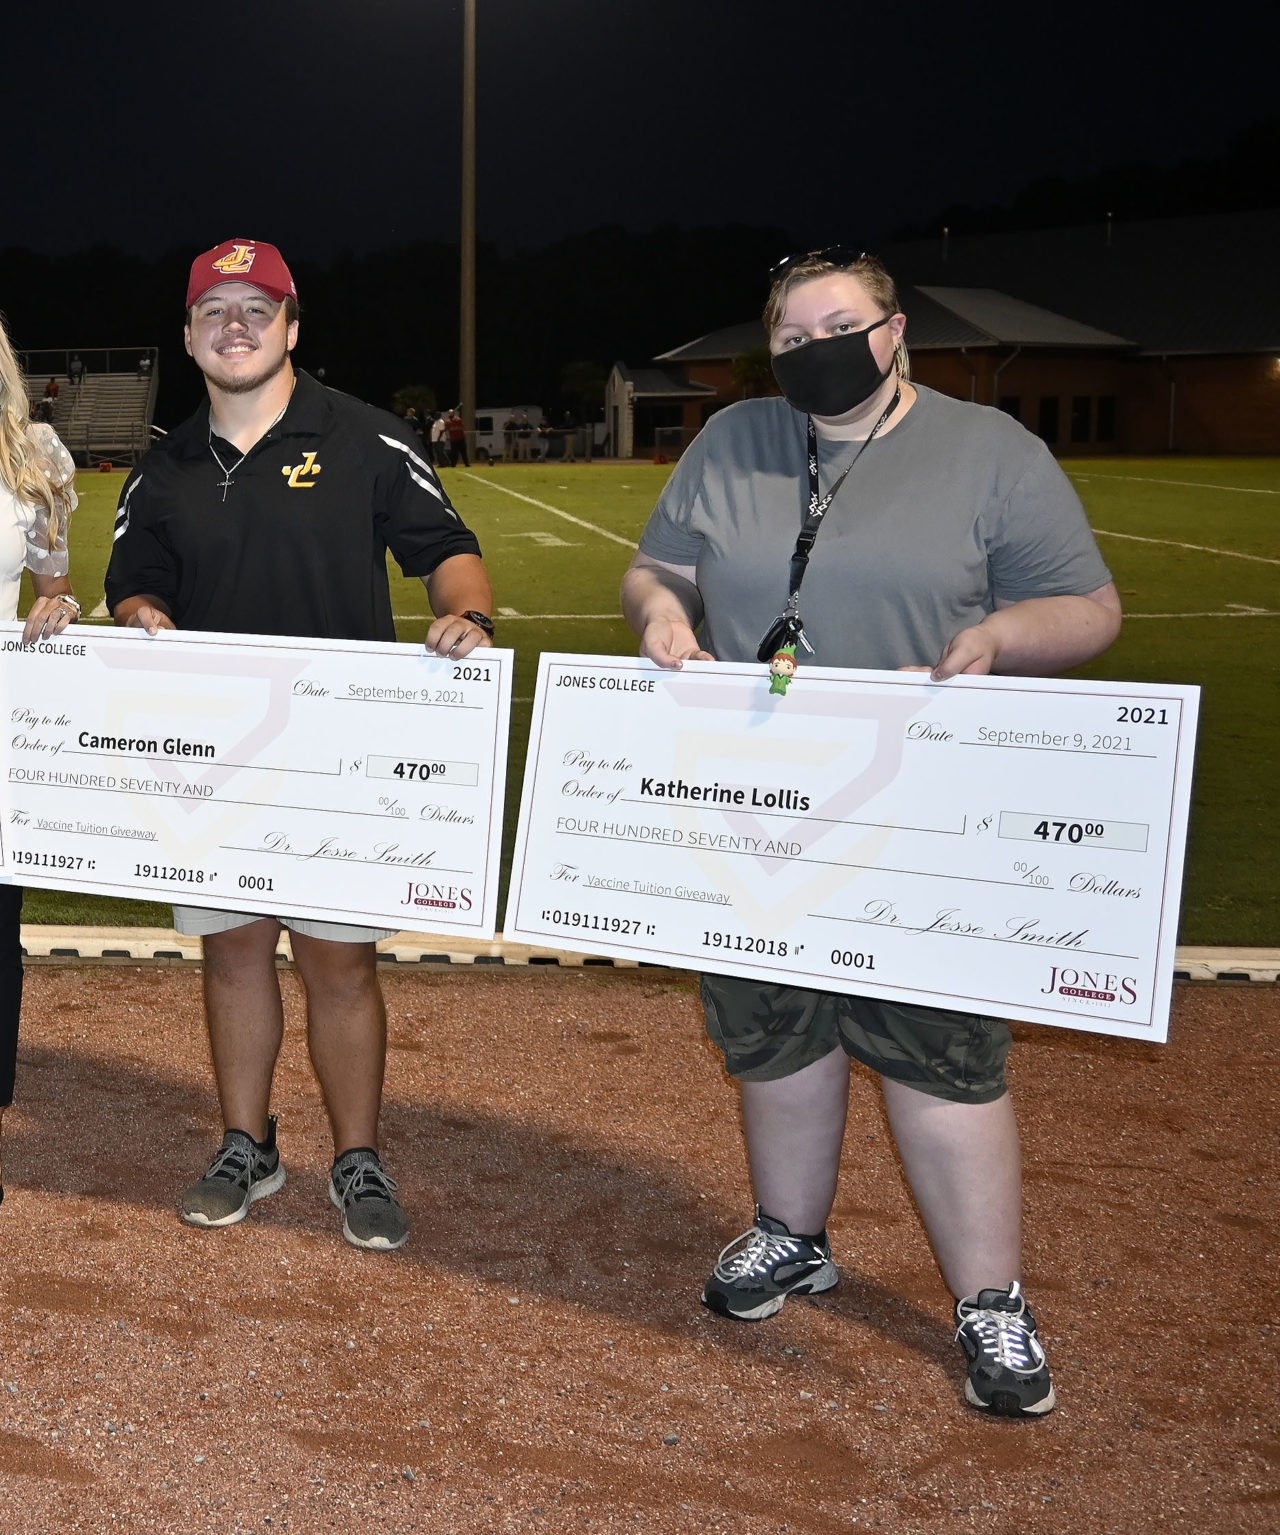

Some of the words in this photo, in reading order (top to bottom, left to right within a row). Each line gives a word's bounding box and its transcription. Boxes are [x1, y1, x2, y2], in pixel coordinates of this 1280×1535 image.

[1, 640, 36, 653] JONES
[39, 643, 86, 656] COLLEGE
[453, 667, 491, 682] 2021
[556, 676, 596, 688] JONES
[599, 678, 655, 692] COLLEGE
[292, 680, 329, 696] Date
[346, 684, 418, 704] September
[434, 690, 464, 703] 2021
[42, 716, 51, 725] to
[55, 714, 71, 726] the
[1117, 707, 1168, 725] 2021
[12, 734, 48, 751] Order
[49, 741, 64, 757] of
[79, 732, 157, 753] Cameron
[163, 738, 215, 758] Glenn
[906, 721, 953, 741] Date
[975, 727, 1070, 751] September
[1090, 735, 1131, 750] 2021
[598, 760, 609, 769] to
[613, 758, 632, 771] the
[9, 768, 45, 784] FOUR
[49, 772, 116, 787] HUNDRED
[120, 778, 180, 796] SEVENTY
[183, 784, 213, 796] AND
[419, 804, 474, 824] Dollars
[562, 780, 604, 798] Order
[607, 787, 623, 805] of
[641, 778, 745, 804] Katherine
[752, 788, 810, 811] Lollis
[35, 818, 74, 833] Vaccine
[73, 822, 110, 836] Tuition
[109, 825, 157, 841] Giveaway
[295, 837, 358, 862] Jesse
[363, 843, 436, 870] Smith
[557, 817, 599, 836] FOUR
[603, 822, 683, 842] HUNDRED
[687, 832, 762, 852] SEVENTY
[764, 840, 801, 856] AND
[1067, 873, 1141, 898] Dollars
[239, 875, 273, 891] 0001
[586, 874, 630, 892] Vaccine
[631, 880, 672, 898] Tuition
[673, 886, 731, 906] Giveaway
[401, 882, 472, 911] JONES
[416, 898, 454, 909] COLLEGE
[904, 907, 985, 939] Jesse
[992, 917, 1090, 952] Smith
[831, 950, 875, 970] 0001
[1041, 967, 1136, 1005] JONES
[1062, 986, 1112, 1001] COLLEGE
